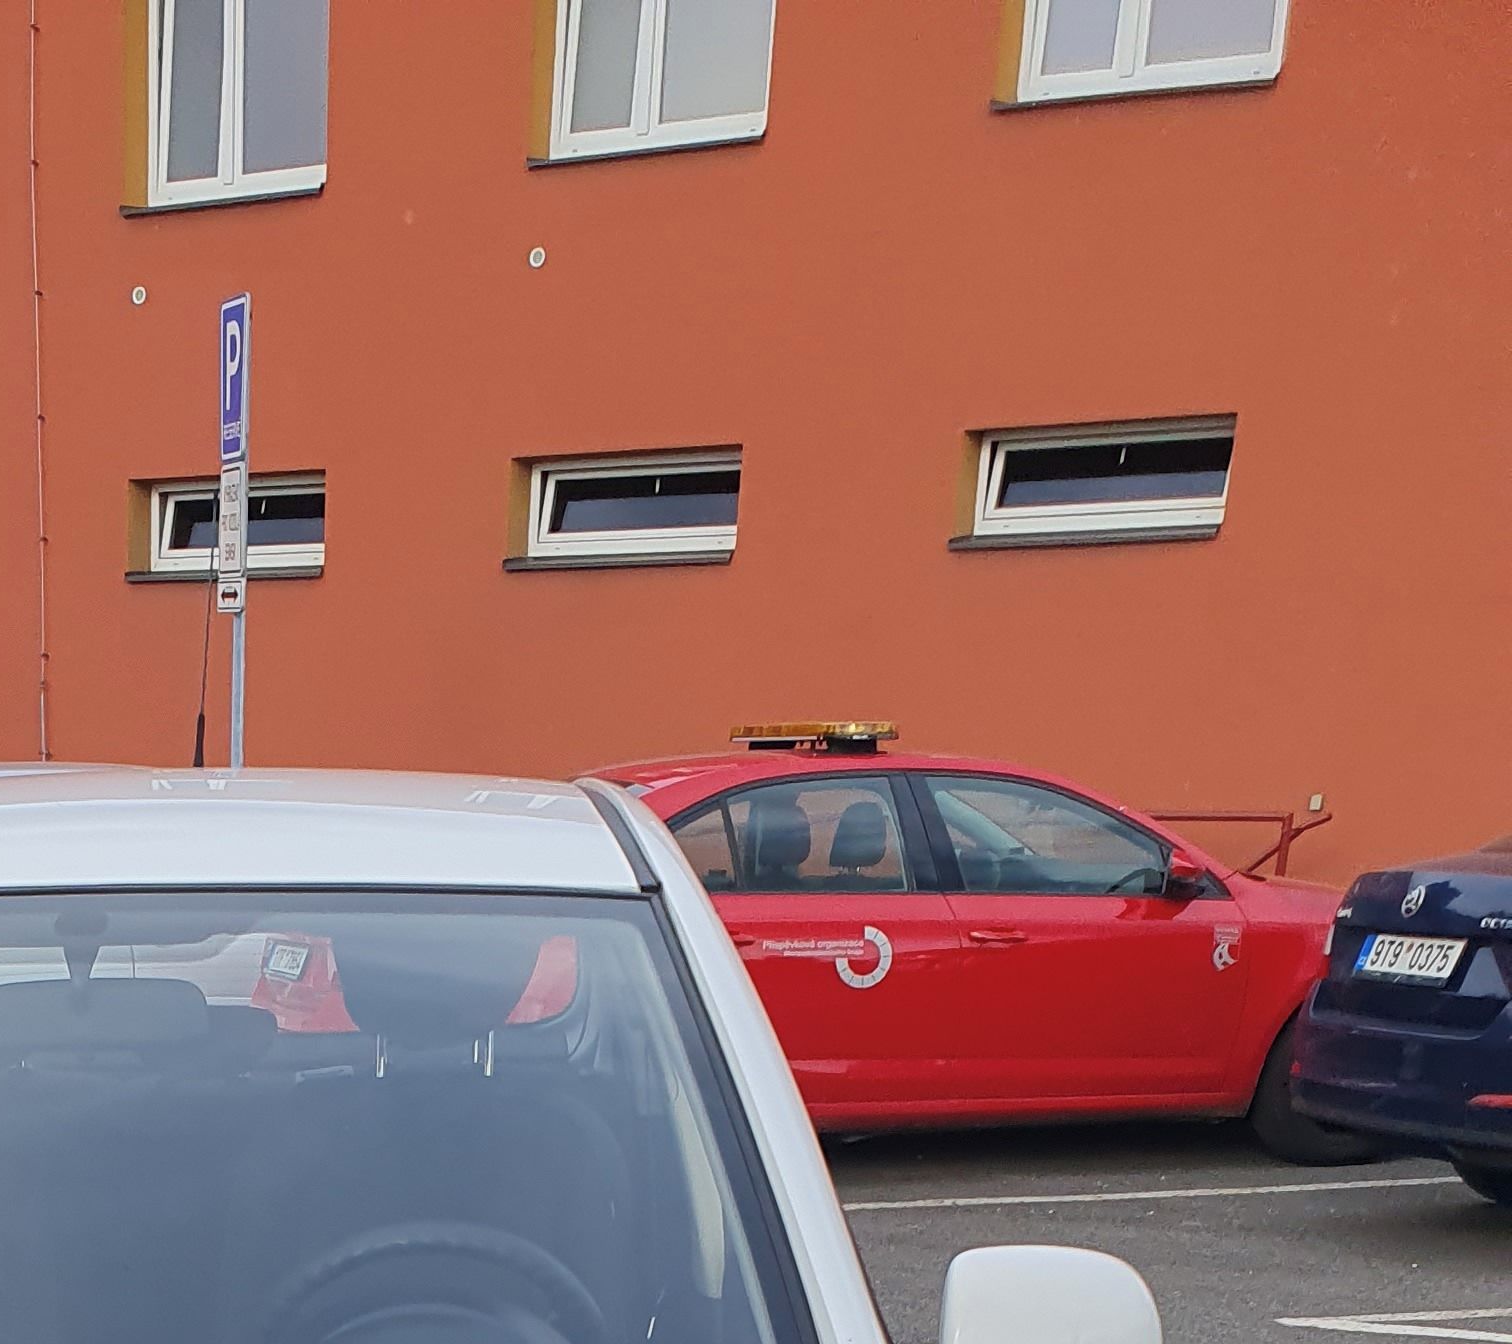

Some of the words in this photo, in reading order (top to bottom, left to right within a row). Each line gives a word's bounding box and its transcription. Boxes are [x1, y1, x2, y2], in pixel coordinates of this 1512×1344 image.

[226, 320, 241, 411] P
[1370, 939, 1404, 968] 9T9
[1409, 943, 1455, 972] 0375
